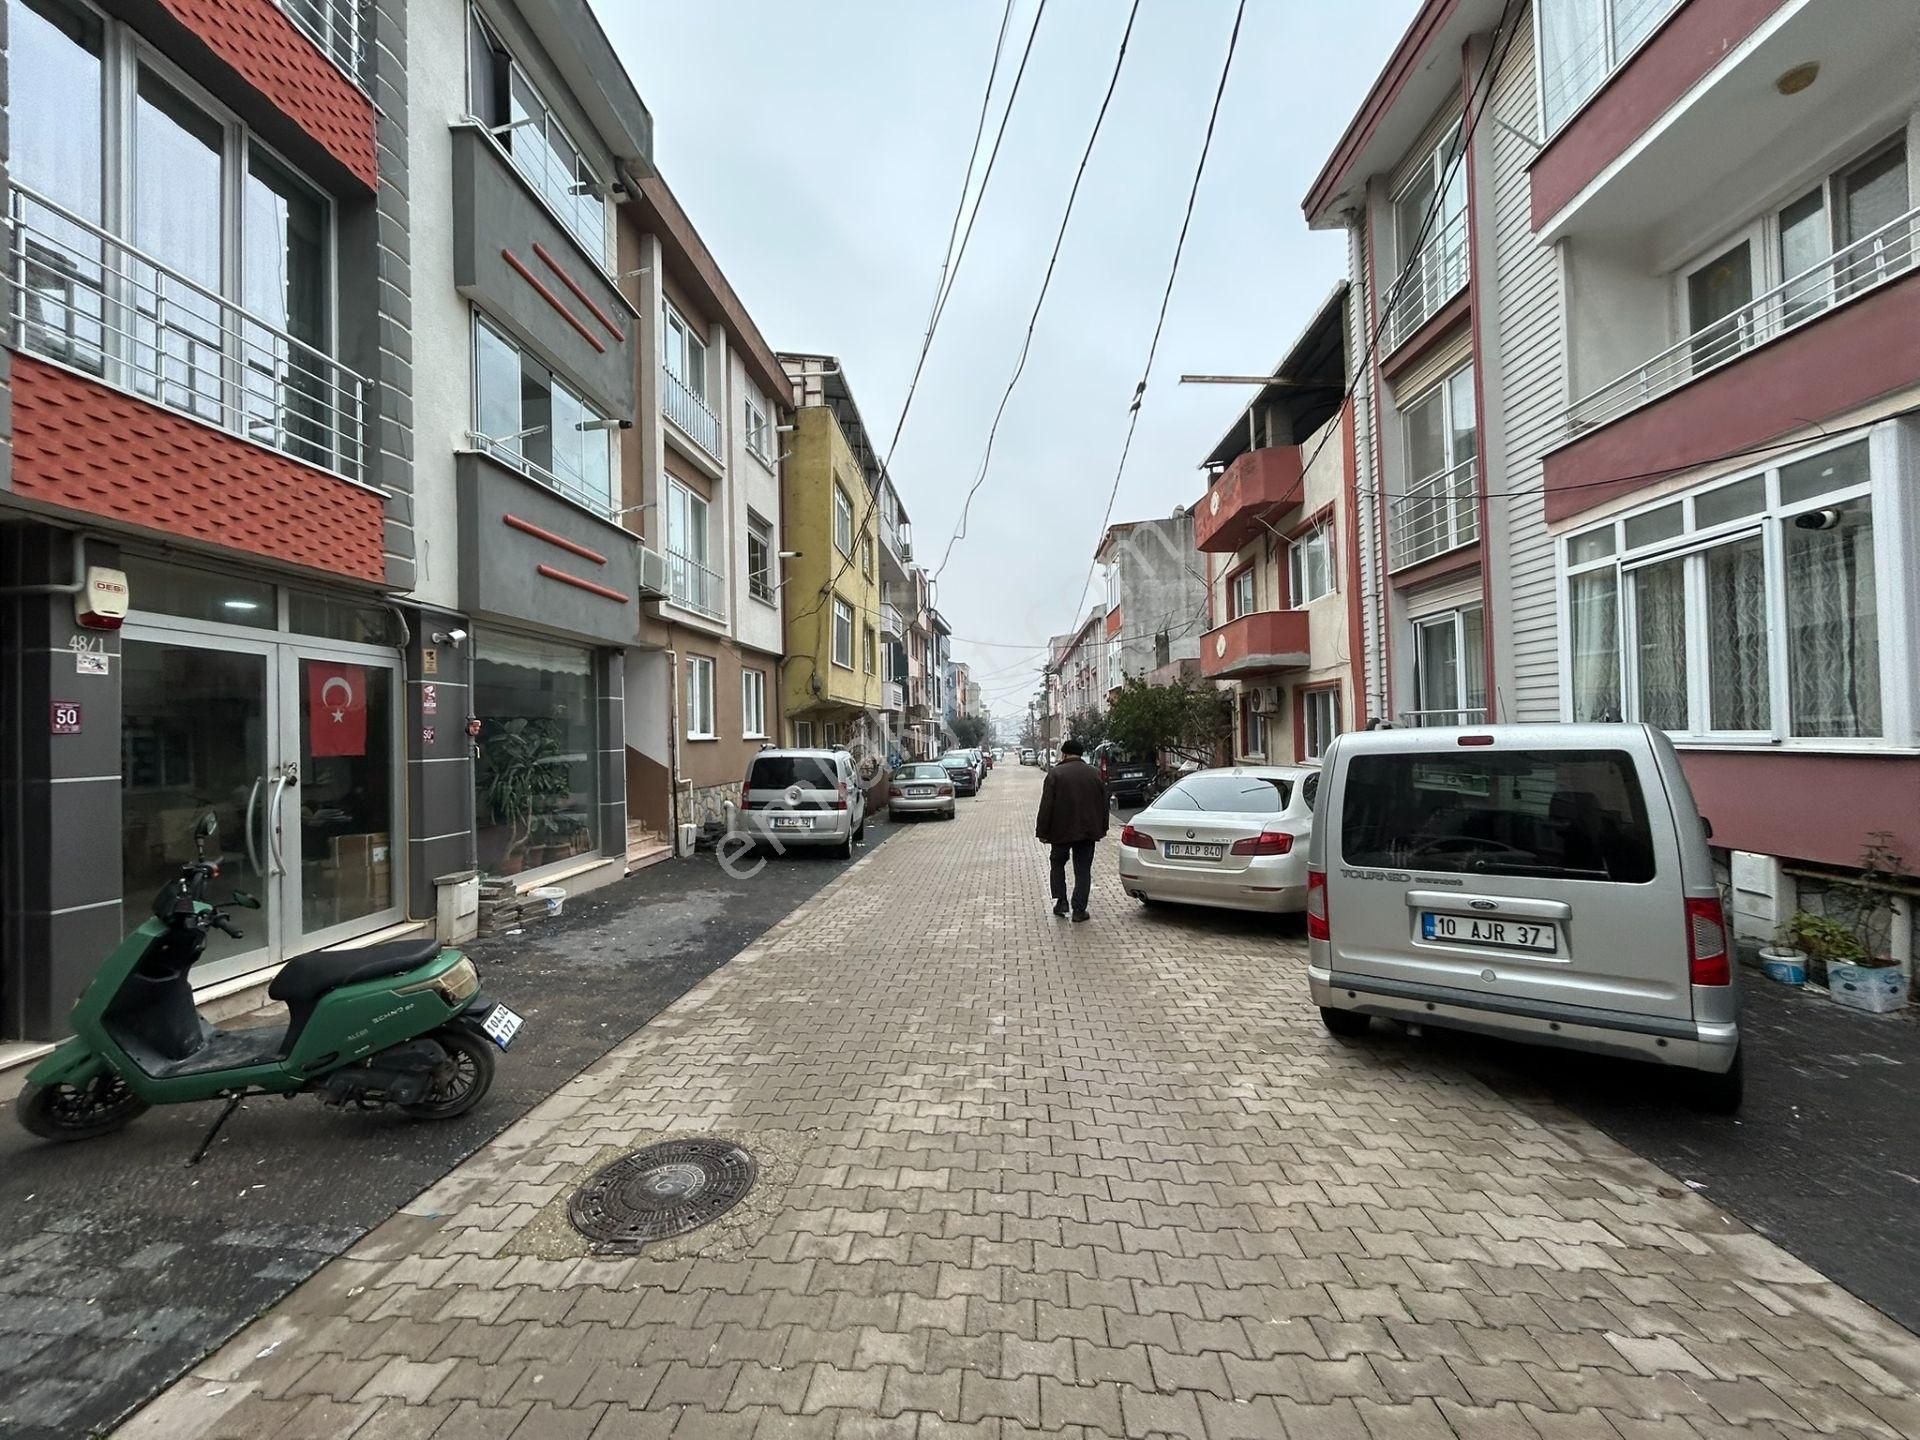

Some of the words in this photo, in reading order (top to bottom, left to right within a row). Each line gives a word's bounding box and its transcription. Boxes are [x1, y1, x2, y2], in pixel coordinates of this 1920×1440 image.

[68, 635, 104, 654] 48/1
[56, 709, 77, 724] 50
[1171, 844, 1180, 855] 10
[1184, 845, 1201, 856] ALP
[1203, 846, 1221, 857] 840
[1438, 917, 1456, 935] 10
[1471, 921, 1505, 942] AJR
[1517, 926, 1541, 945] 37
[501, 1019, 516, 1038] 177
